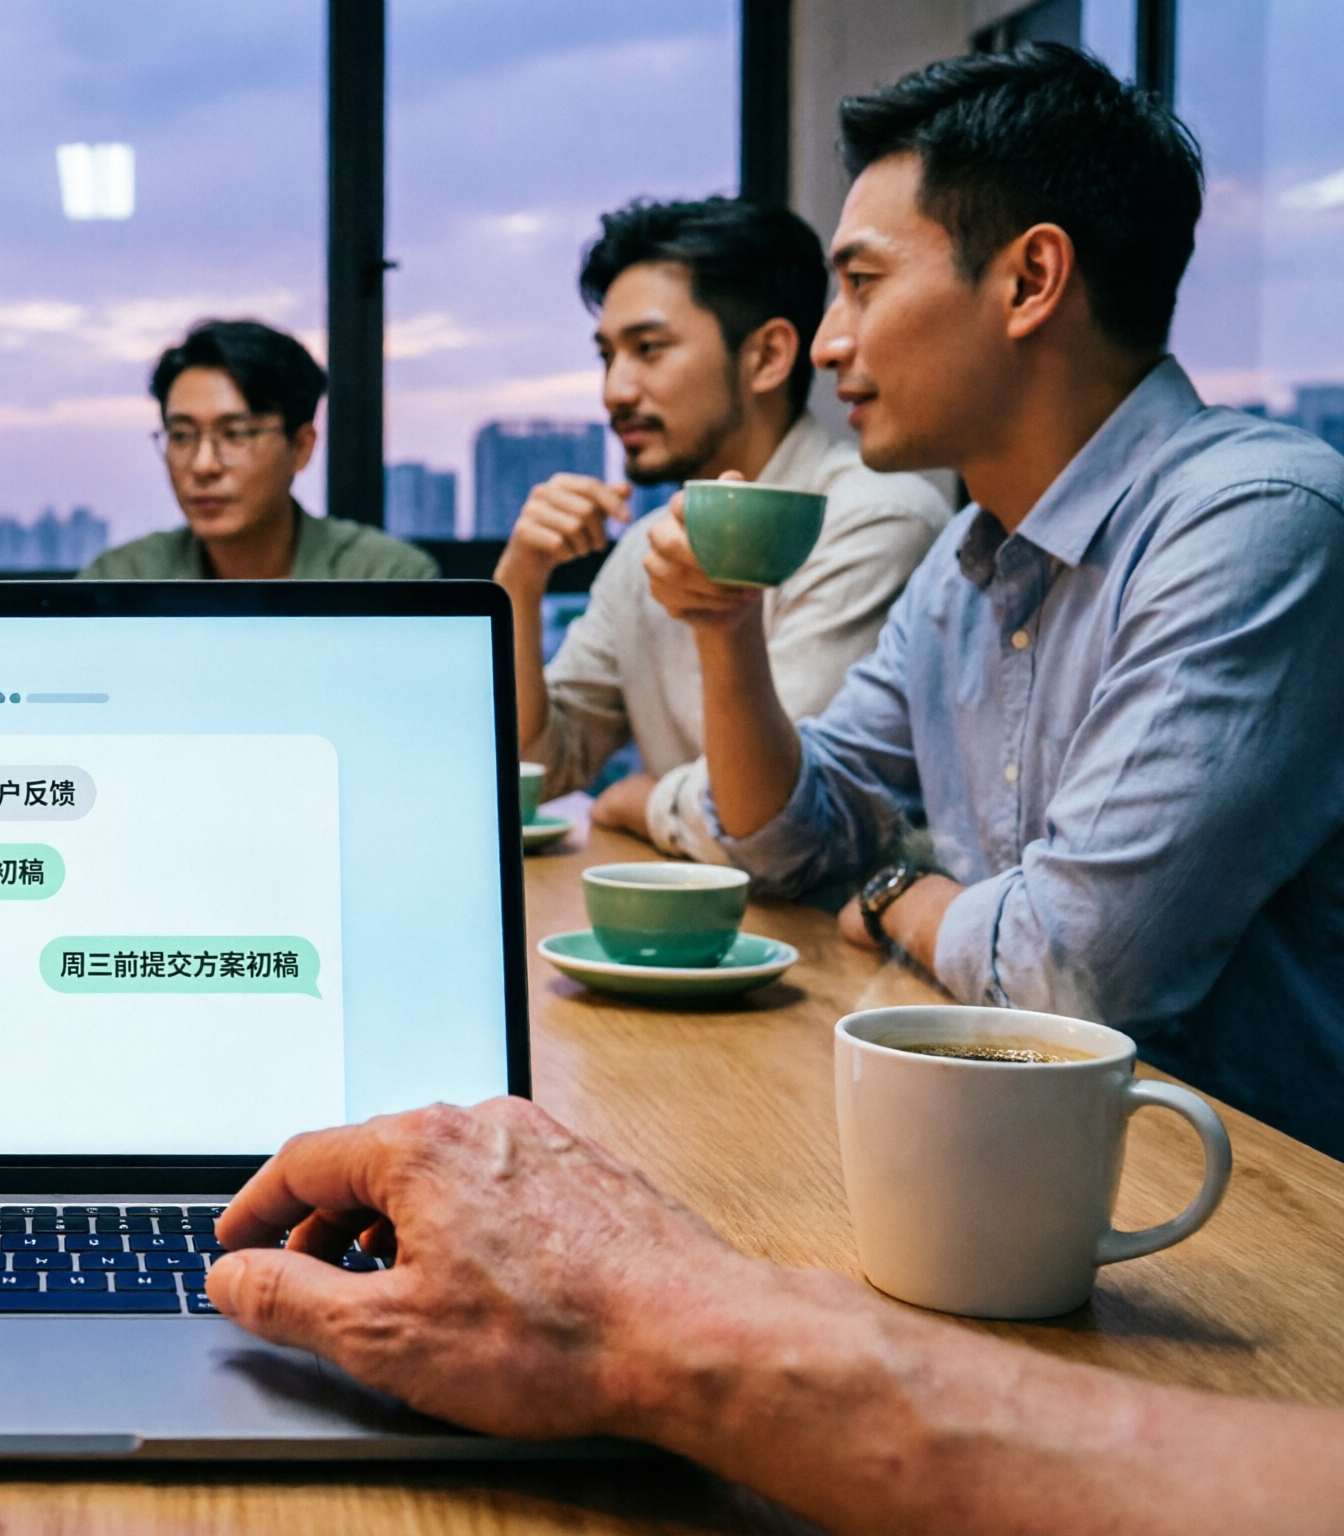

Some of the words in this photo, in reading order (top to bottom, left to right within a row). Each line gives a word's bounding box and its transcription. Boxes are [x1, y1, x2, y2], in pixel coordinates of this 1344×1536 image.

[59, 949, 299, 979] 周三前提交方案初稿
